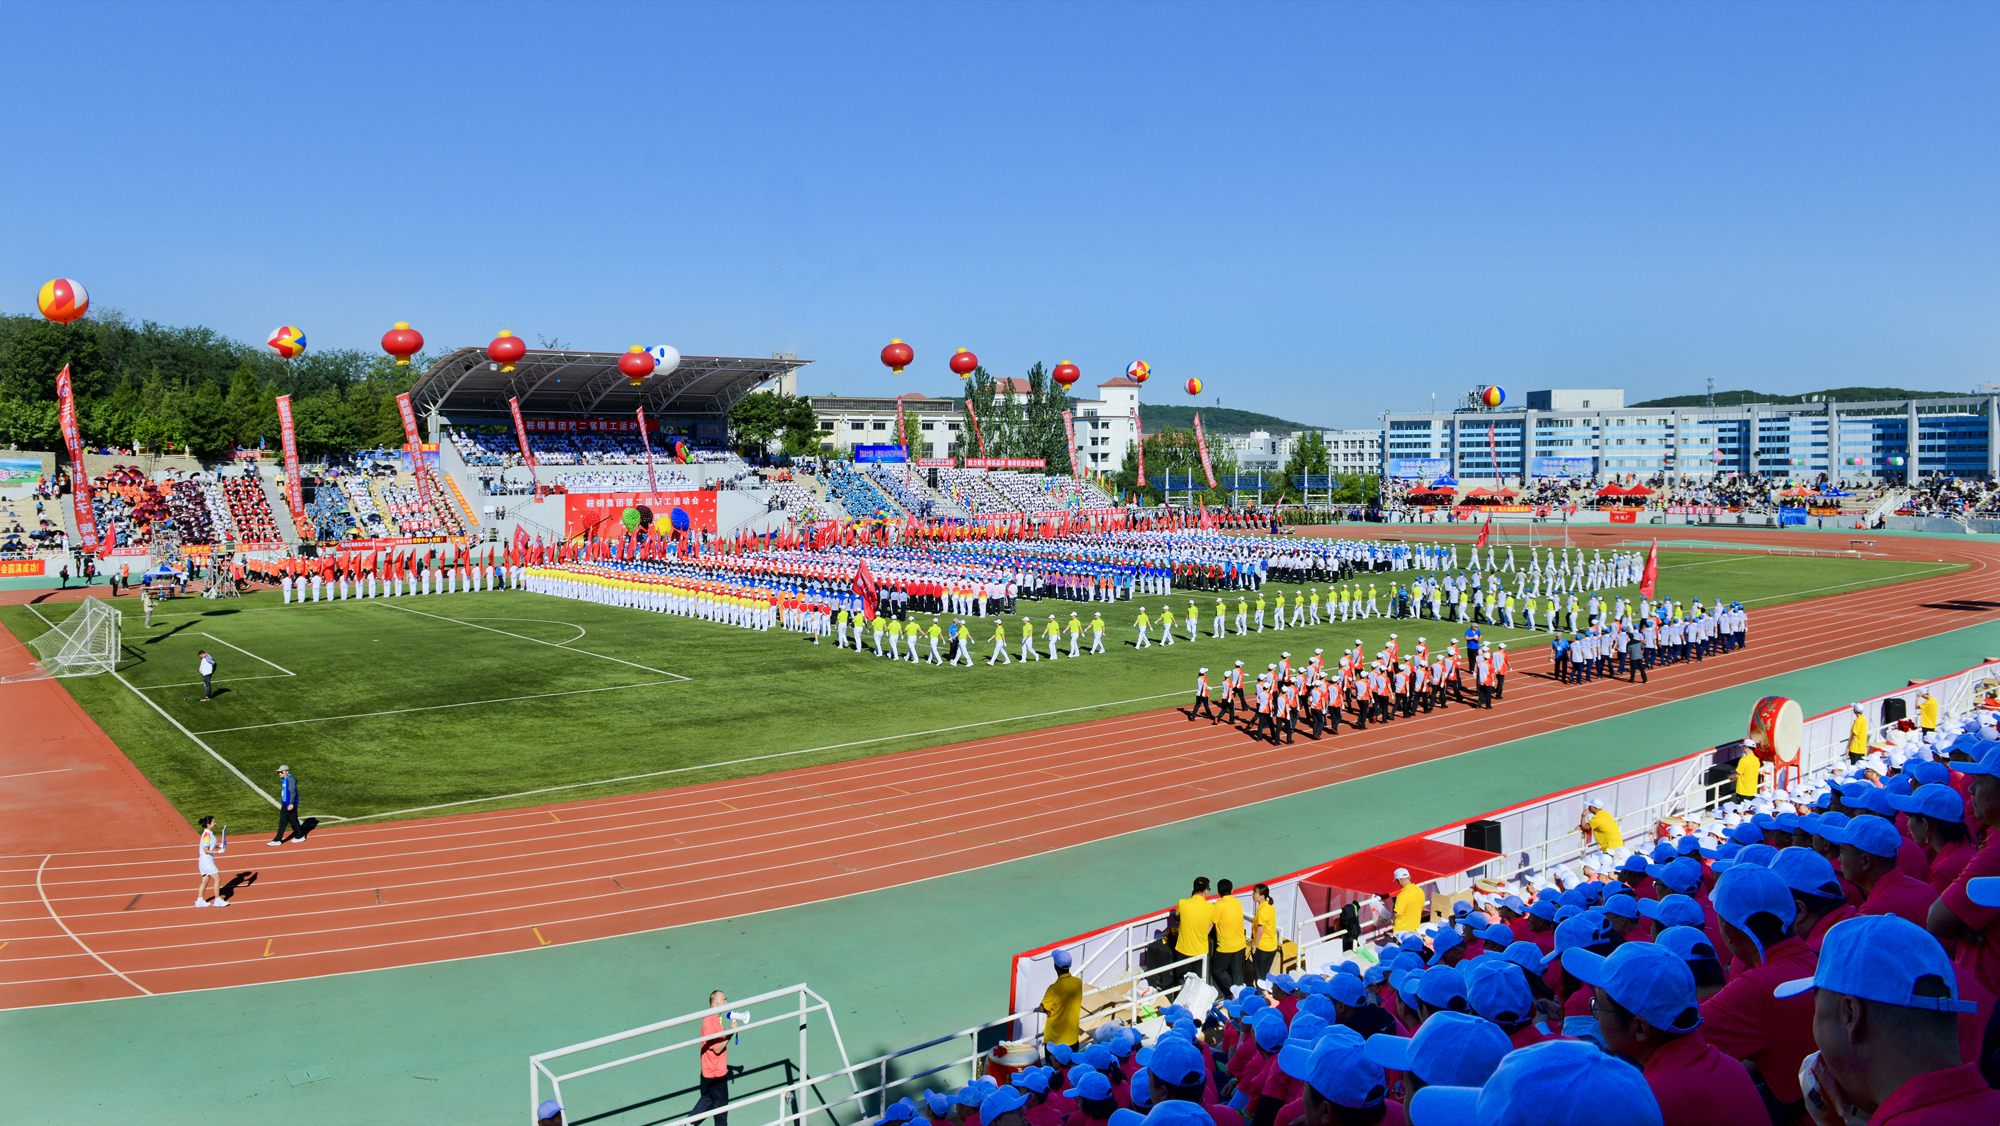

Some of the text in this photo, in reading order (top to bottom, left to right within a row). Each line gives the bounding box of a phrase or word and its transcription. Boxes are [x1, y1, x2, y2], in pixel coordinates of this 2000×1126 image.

[586, 496, 699, 508] 鞍钢集团第二届职工运动会
[0, 563, 39, 574] 会圆满成功!
